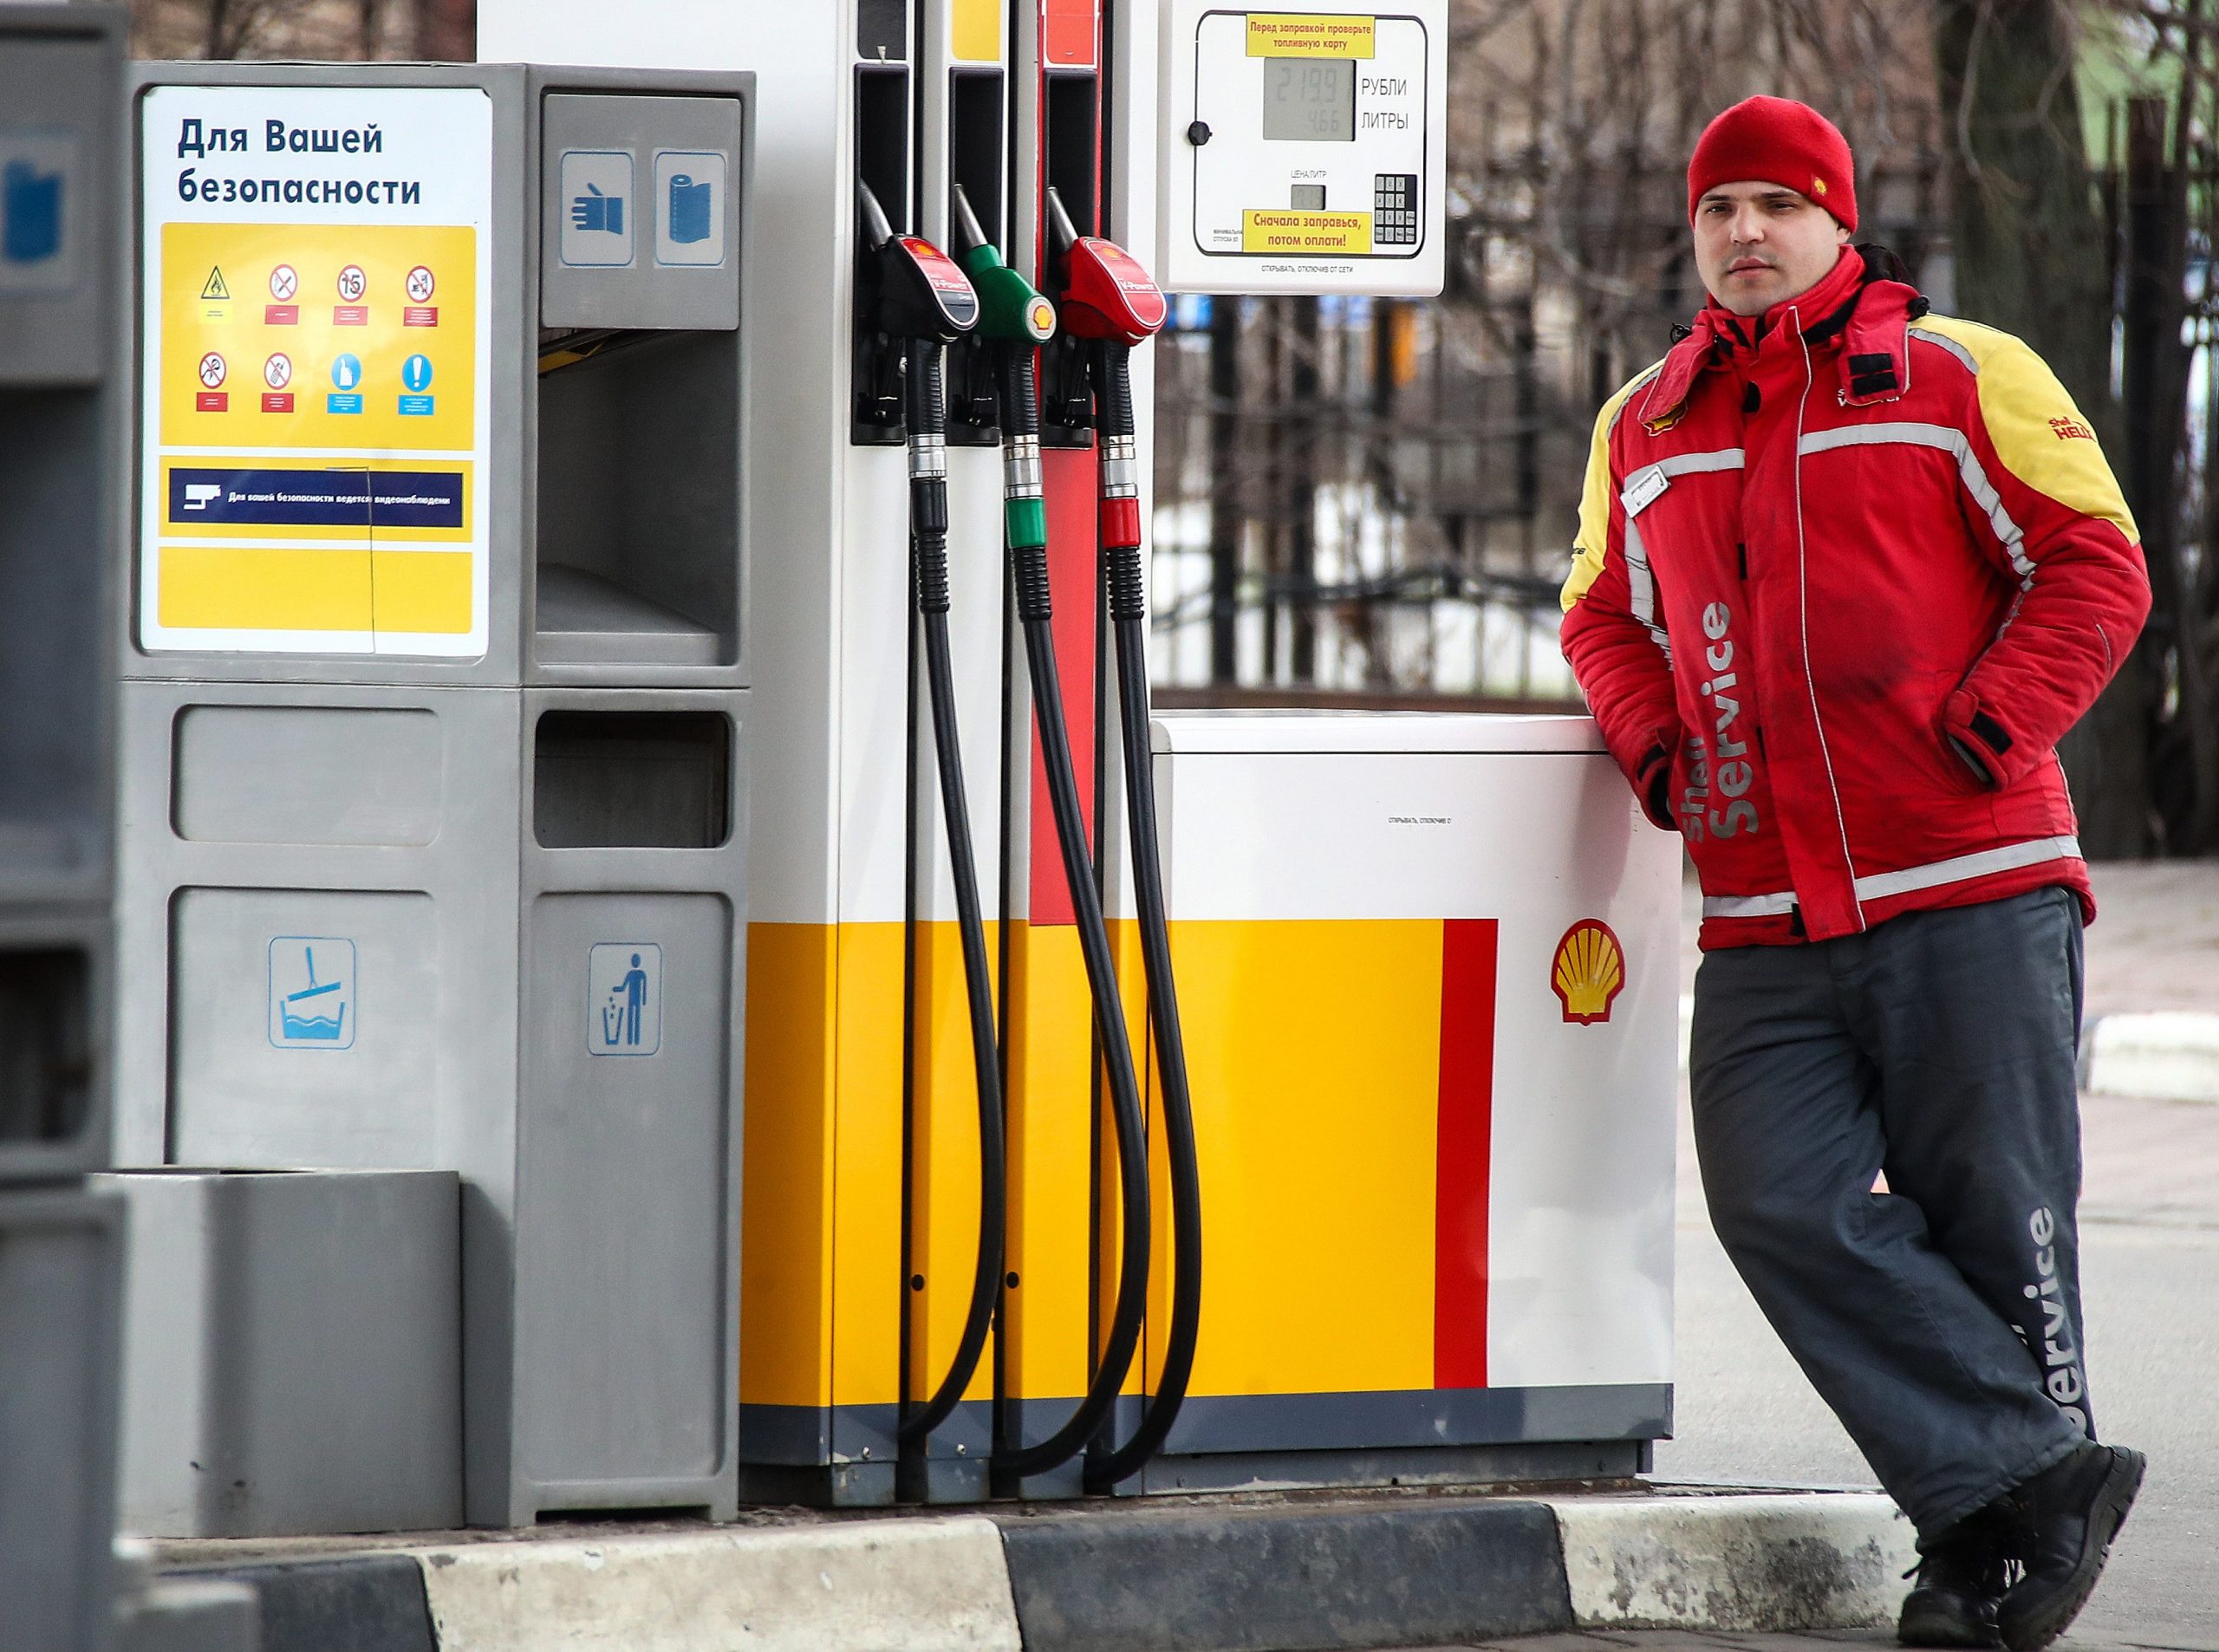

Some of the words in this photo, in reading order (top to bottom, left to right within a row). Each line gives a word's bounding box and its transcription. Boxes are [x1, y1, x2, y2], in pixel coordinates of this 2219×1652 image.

[1250, 21, 1277, 34] Перед
[1279, 23, 1324, 35] заправкой
[1328, 25, 1371, 36] проверьте
[1273, 39, 1320, 50] топливную
[1323, 41, 1348, 51] карту
[1362, 78, 1407, 95] РУБЛИ
[1362, 112, 1409, 129] ЛИТРЫ
[178, 119, 248, 159] Для
[266, 120, 382, 153] Вашей
[179, 167, 420, 205] безопасности
[1253, 213, 1300, 226] Сначала
[1303, 217, 1361, 231] заправься,
[1268, 236, 1301, 246] потом
[1305, 234, 1346, 247] оплати!
[228, 491, 246, 503] Для
[277, 492, 335, 503] безопасности
[1701, 602, 1760, 841] Service
